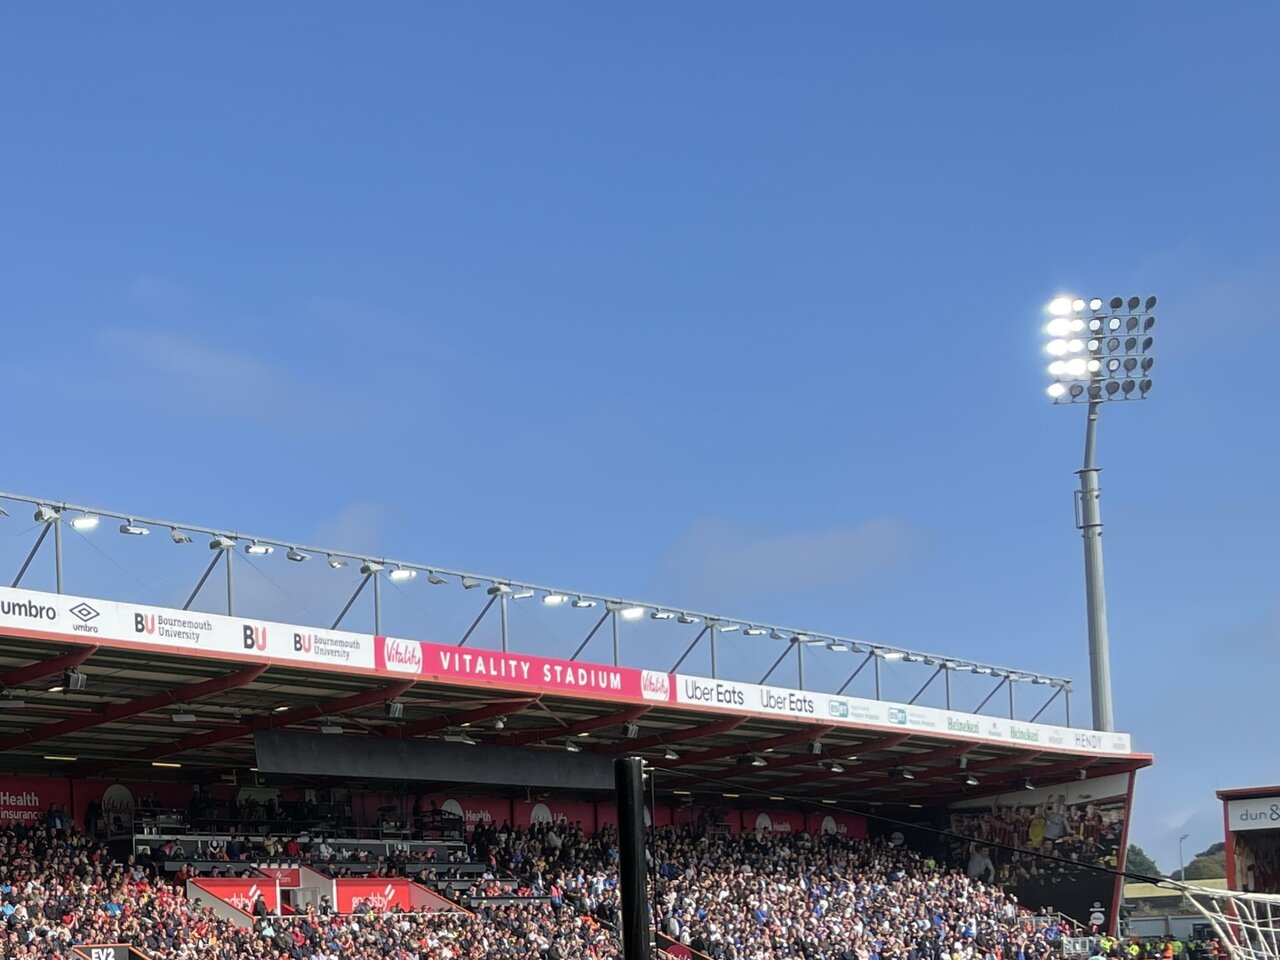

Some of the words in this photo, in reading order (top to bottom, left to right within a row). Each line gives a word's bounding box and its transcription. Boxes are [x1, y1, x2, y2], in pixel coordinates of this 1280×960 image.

[1, 600, 57, 621] umbro
[72, 623, 98, 633] umbro
[134, 612, 155, 634] BU
[157, 615, 212, 631] Bournemouth
[158, 626, 200, 643] University
[243, 624, 267, 651] BU
[293, 633, 311, 653] BU
[314, 634, 360, 650] Bournemouth
[314, 644, 350, 660] University
[386, 639, 421, 669] Vitality
[440, 651, 530, 679] VITALITY
[544, 664, 621, 690] STADIUM
[642, 673, 669, 699] Vitality
[685, 679, 714, 701] Uber
[718, 684, 744, 705] Eats
[760, 689, 788, 709] Uber
[789, 693, 814, 713] Eats
[947, 717, 979, 734] Heineken
[1010, 725, 1039, 742] Heineken
[1075, 733, 1102, 748] HENDY
[0, 792, 39, 807] Health
[466, 810, 491, 821] Health
[1240, 809, 1267, 821] dun
